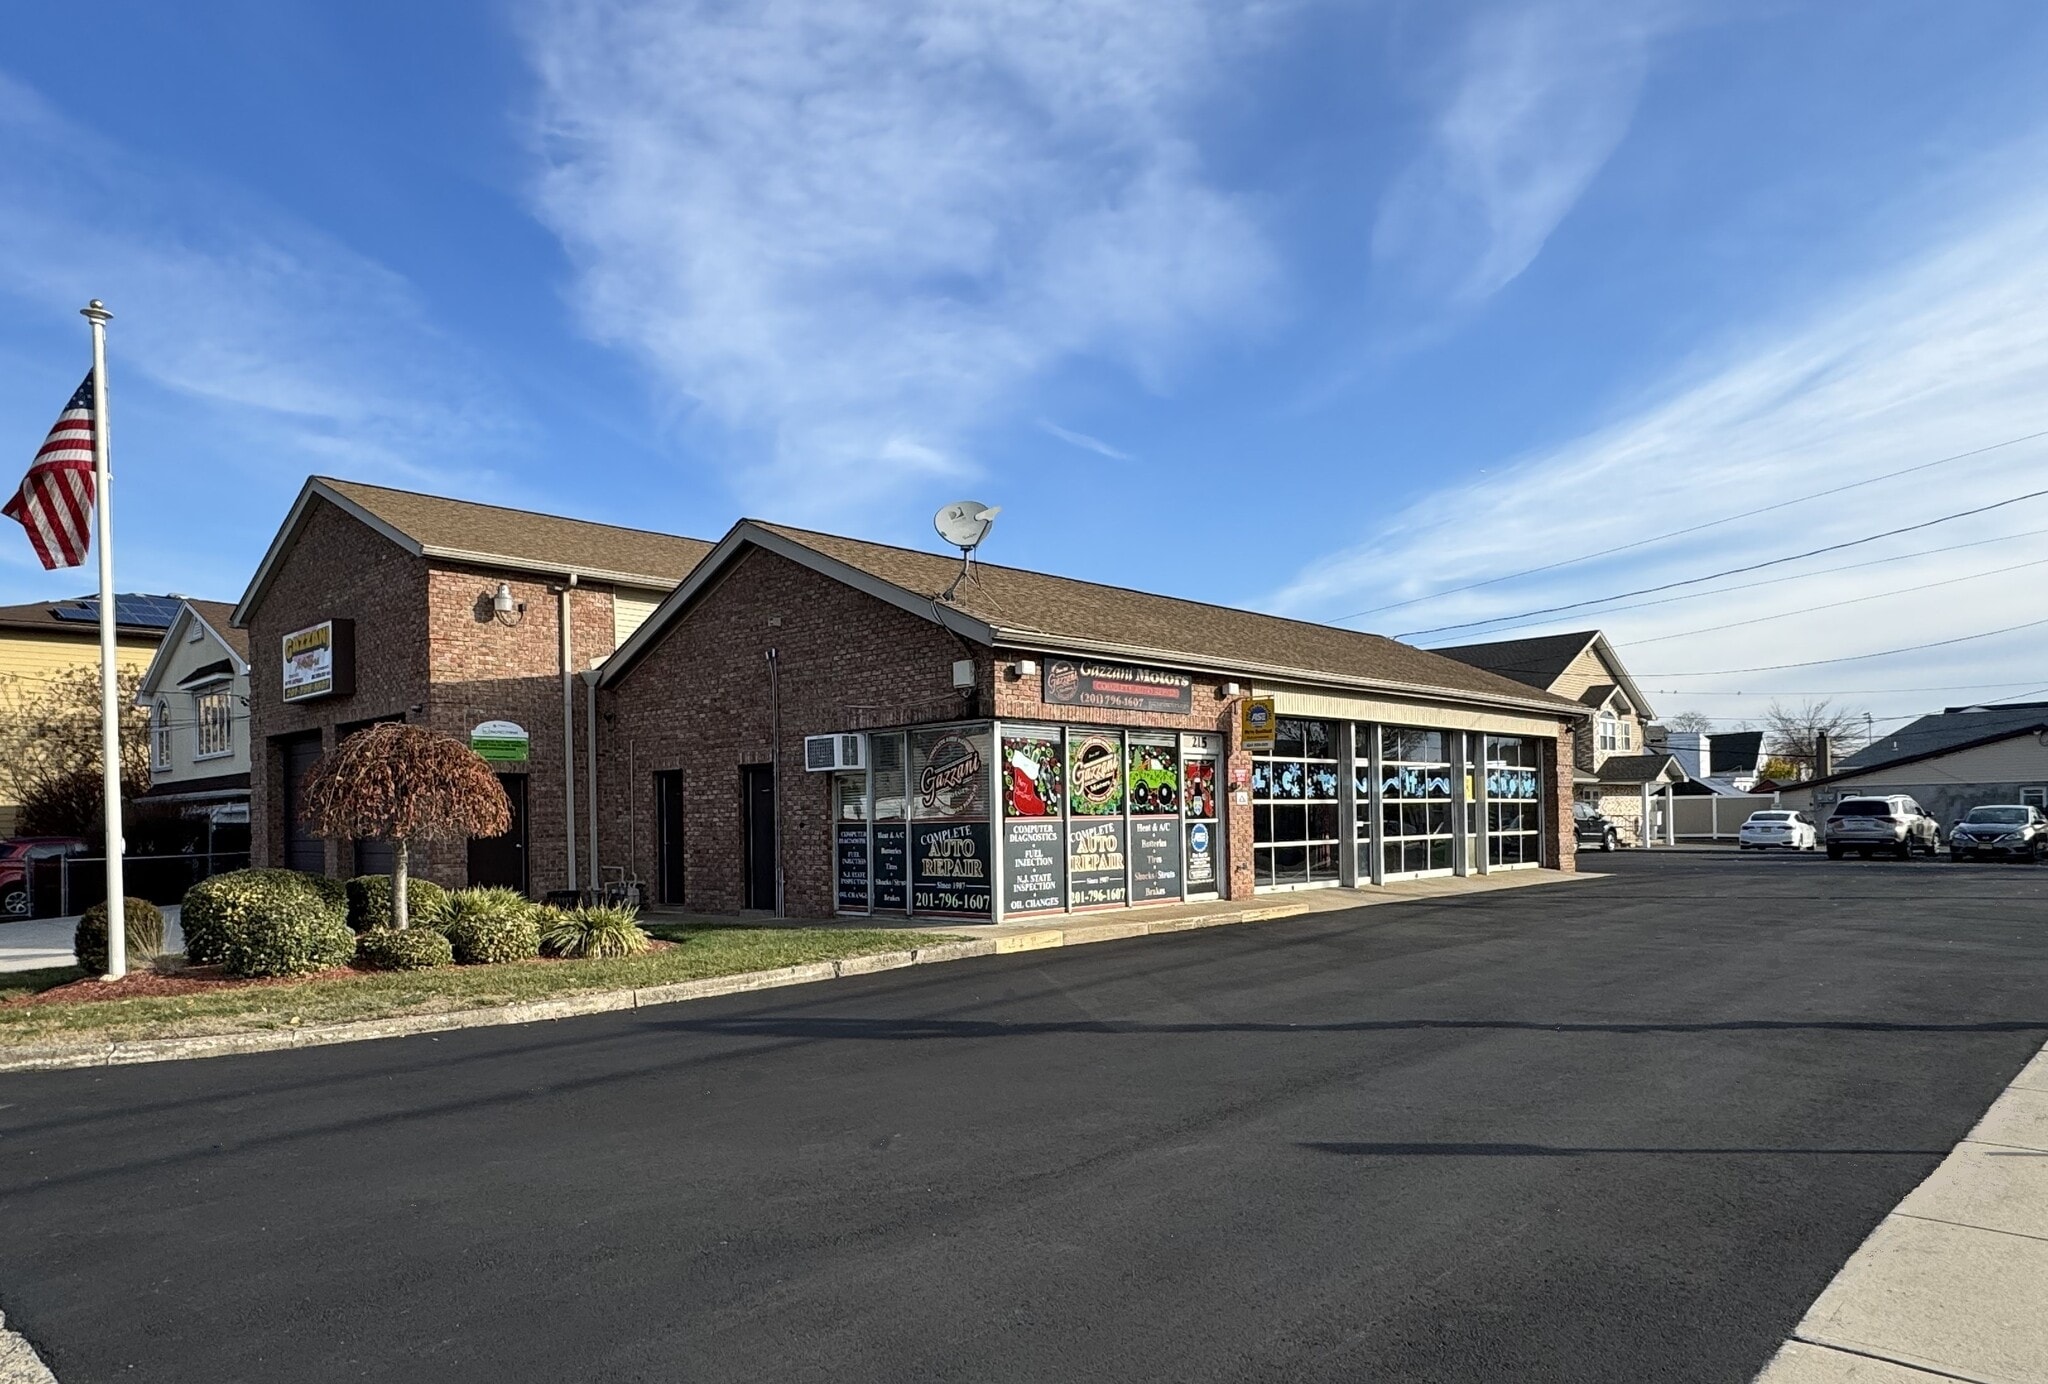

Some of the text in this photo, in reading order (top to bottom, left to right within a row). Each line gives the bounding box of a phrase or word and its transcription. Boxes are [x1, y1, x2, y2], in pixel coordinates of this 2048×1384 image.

[1080, 661, 1190, 687] Gazzani Motors
[1104, 694, 1144, 707] 796-1607
[1192, 736, 1208, 748] 215
[921, 753, 979, 807] Gazzani
[1072, 753, 1119, 796] Gazzani
[1013, 824, 1054, 834] COMPUTER
[1070, 822, 1115, 843] COMPLETE
[1136, 824, 1151, 832] Heat
[920, 825, 972, 846] COMPLETE
[1010, 832, 1058, 842] DIAGNOSTICS
[928, 838, 975, 858] AUTO
[1076, 834, 1118, 854] AUTO
[1025, 850, 1044, 858] FUEL
[1147, 855, 1162, 864] Tires
[922, 858, 984, 878] REPAIR
[1015, 857, 1054, 868] INJECTION
[1070, 852, 1124, 872] REPAIR
[1030, 873, 1052, 883] STATE
[1014, 882, 1056, 892] INSPECTION
[1145, 886, 1166, 896] Brakes
[916, 892, 990, 910] 201-796-1607
[1071, 888, 1126, 904] 201-796-1607
[1010, 898, 1060, 910] OIL CHANGES
